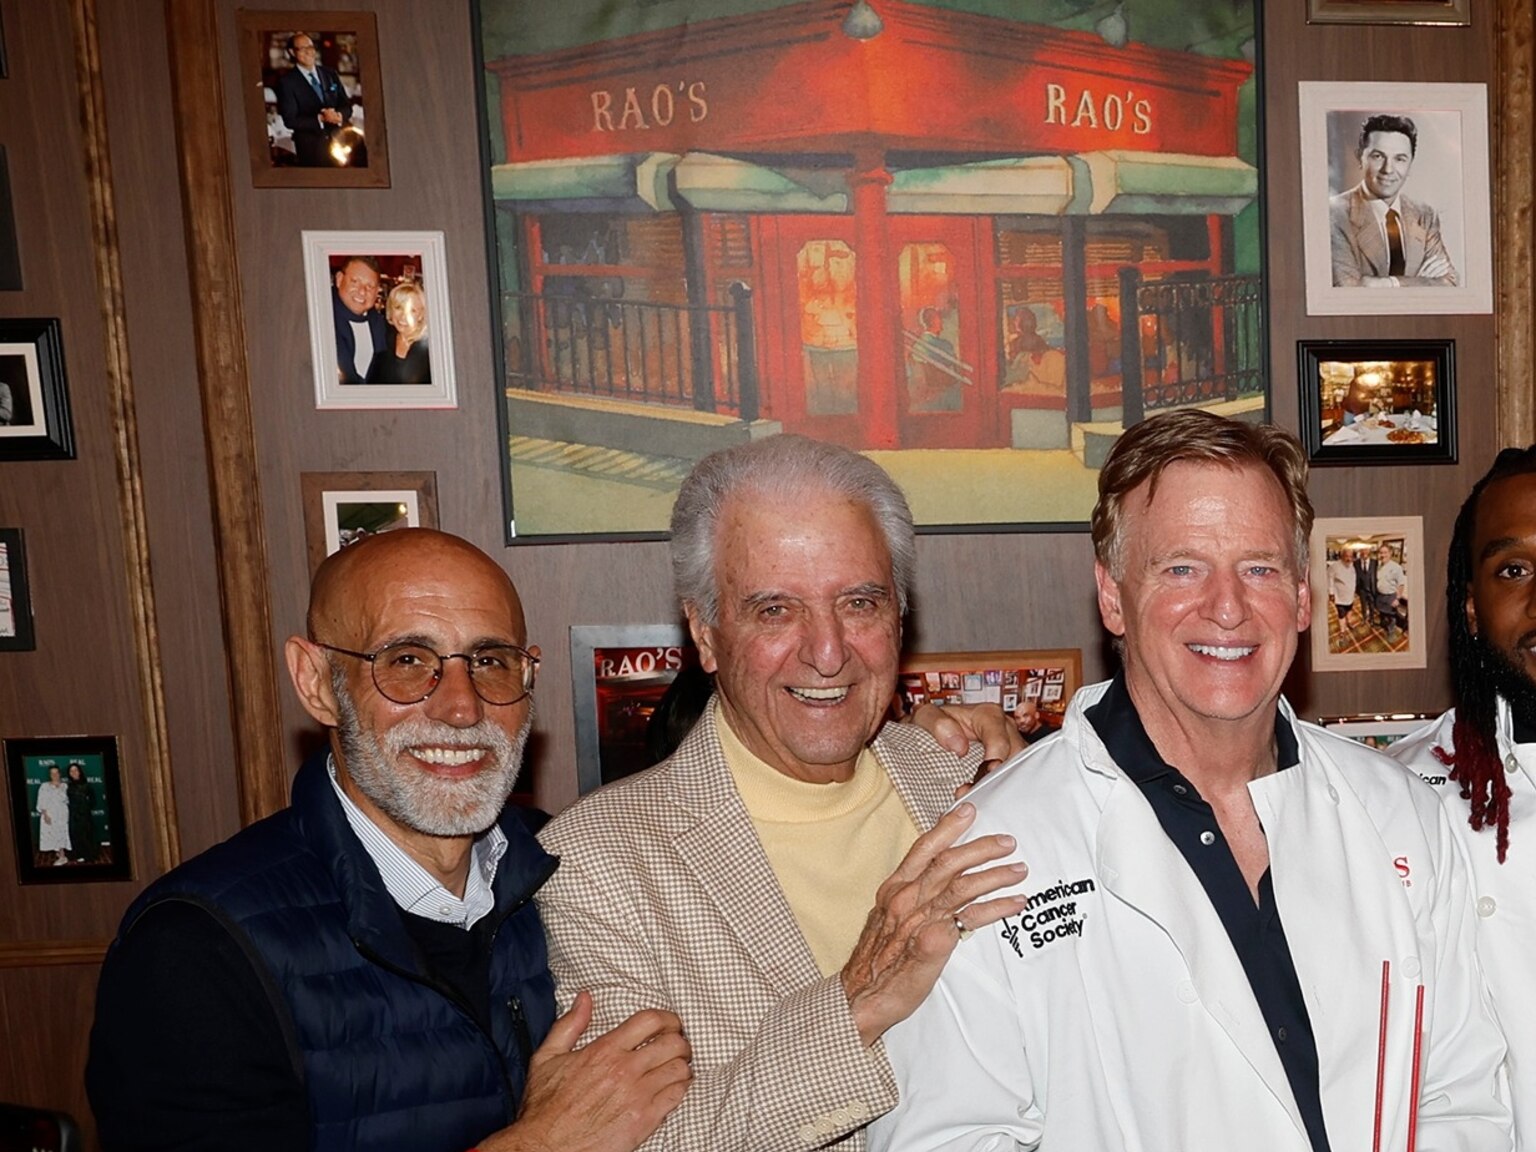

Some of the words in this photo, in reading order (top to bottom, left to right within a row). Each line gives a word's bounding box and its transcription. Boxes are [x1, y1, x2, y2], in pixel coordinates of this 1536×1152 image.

[590, 81, 708, 132] RAO'S
[1043, 83, 1152, 134] RAO'S
[601, 647, 683, 677] RAO'S
[1021, 902, 1076, 932] Cancer
[1030, 918, 1084, 949] Society
